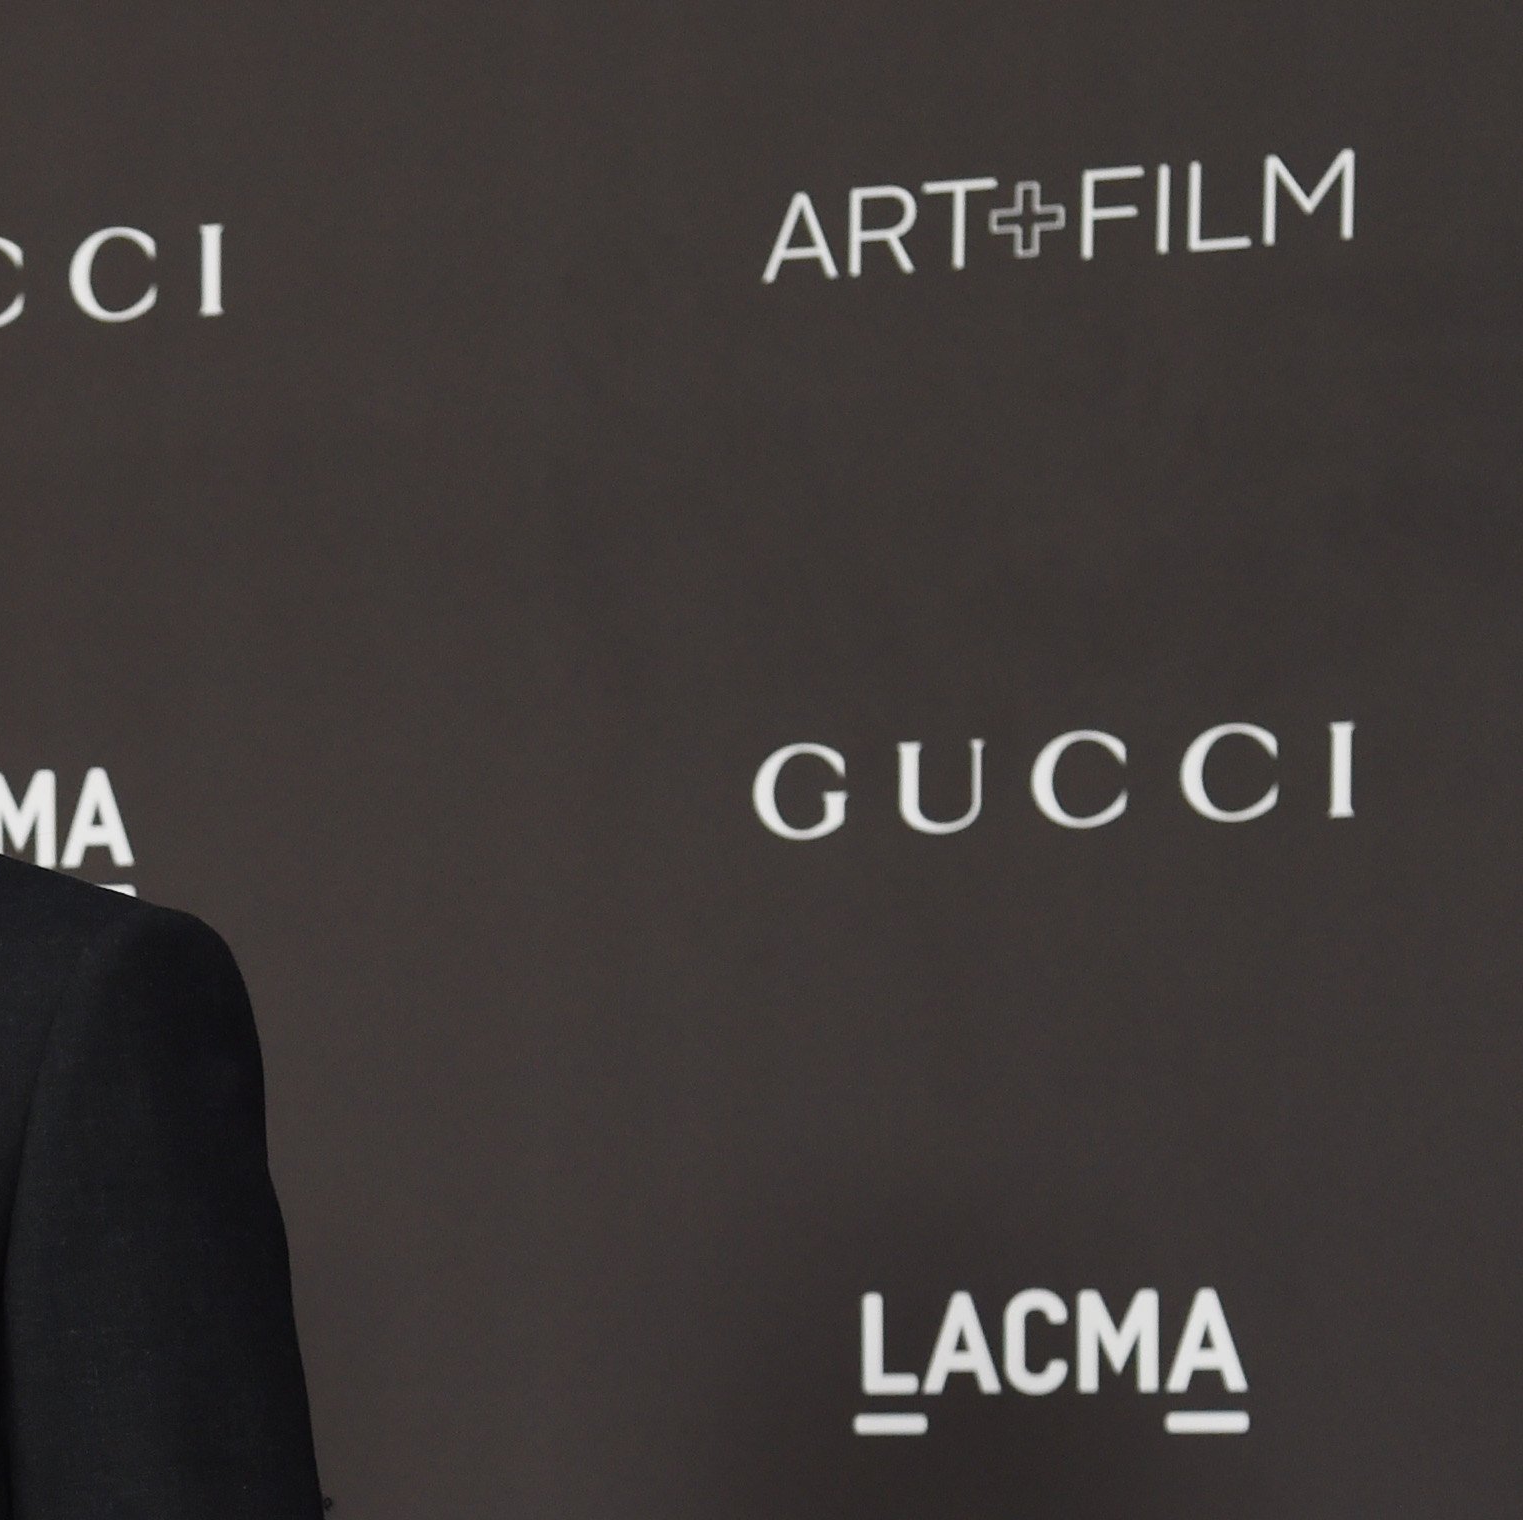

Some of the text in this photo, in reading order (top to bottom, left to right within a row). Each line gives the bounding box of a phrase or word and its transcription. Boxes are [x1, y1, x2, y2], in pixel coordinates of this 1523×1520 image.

[762, 147, 1356, 284] ART+FILM
[752, 721, 1355, 841] GUCCI
[861, 1287, 1249, 1396] LACMA
